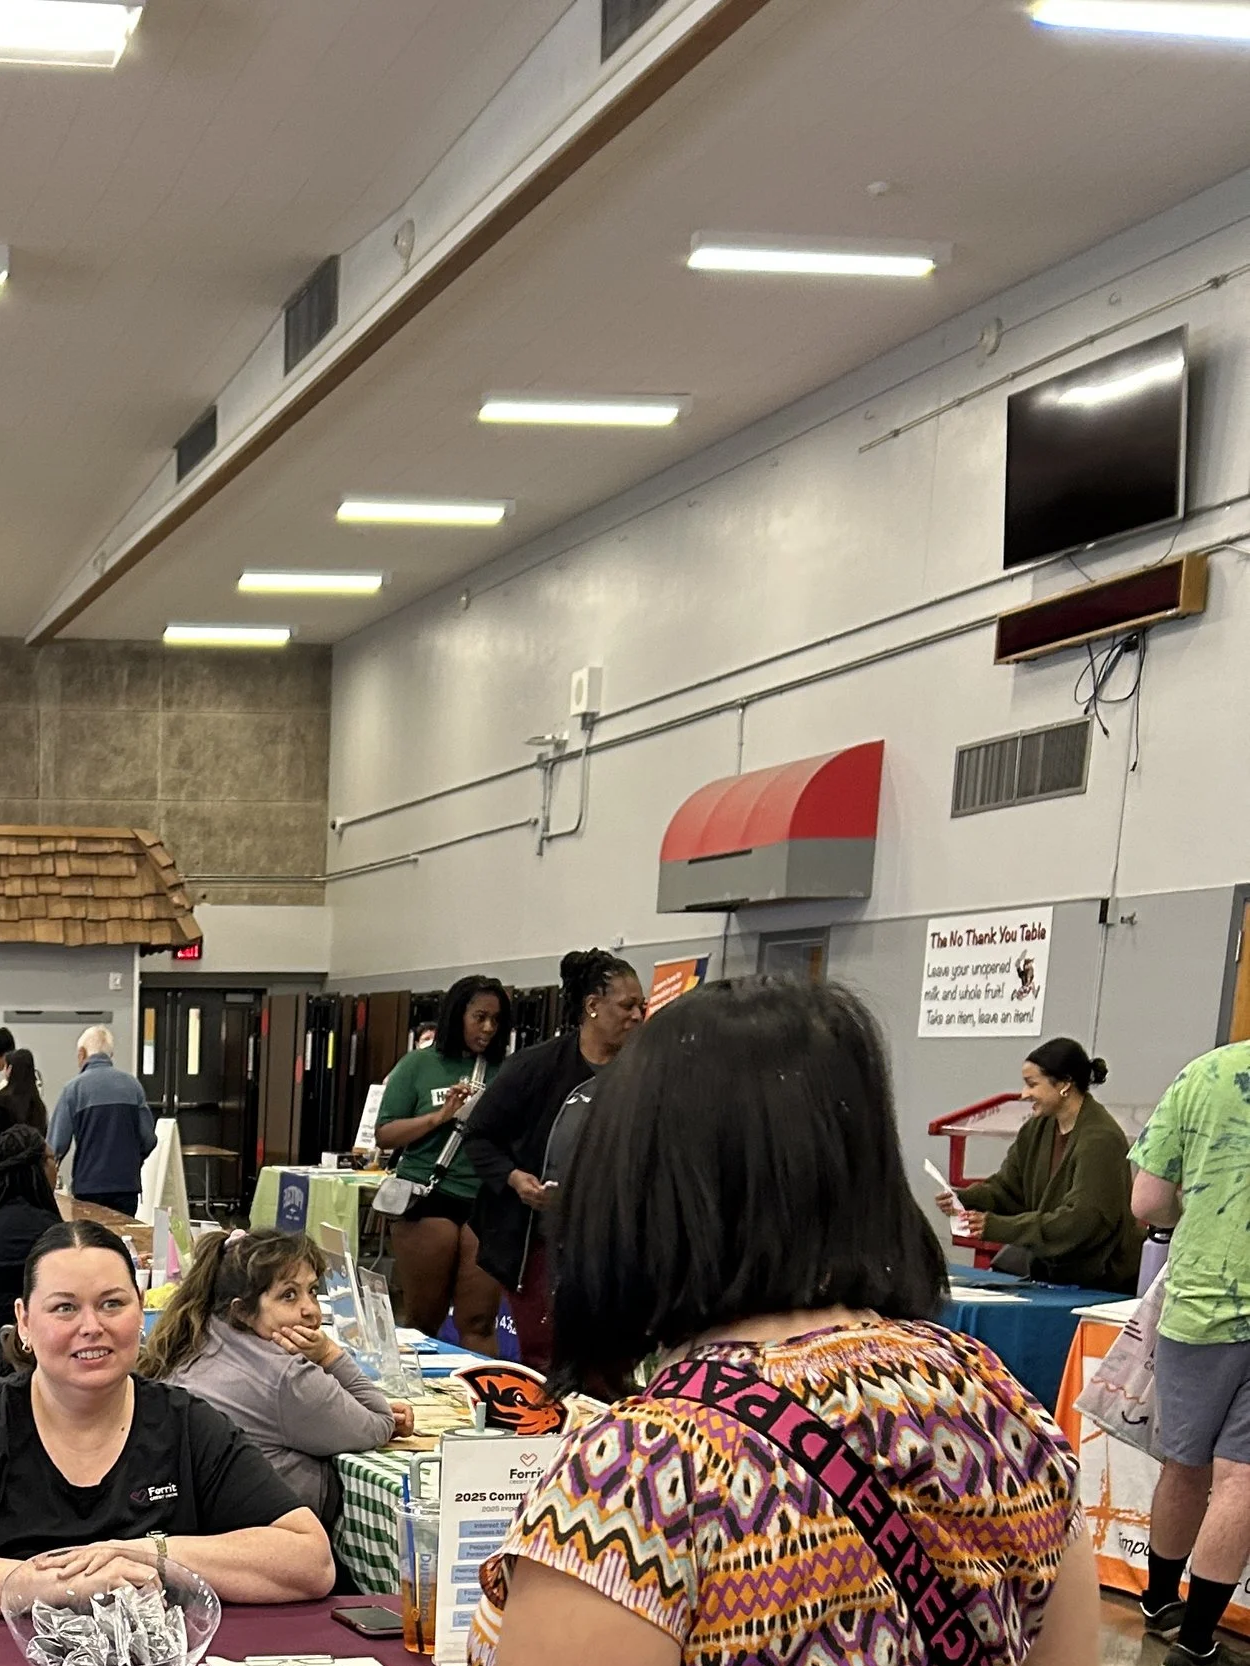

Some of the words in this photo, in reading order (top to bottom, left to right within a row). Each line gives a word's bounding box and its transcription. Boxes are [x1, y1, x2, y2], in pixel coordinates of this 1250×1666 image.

[931, 931, 947, 949] The
[950, 930, 963, 947] No
[966, 927, 997, 946] Thank
[999, 925, 1017, 943] You
[1020, 922, 1046, 941] Table
[927, 962, 949, 978] Leave
[952, 964, 969, 981] your
[972, 957, 1011, 979] unopened
[924, 985, 939, 1000] milk
[942, 984, 958, 1000] and
[959, 984, 981, 1000] whole
[985, 982, 1005, 999] fruit!
[927, 1009, 943, 1025] Take
[946, 1013, 956, 1025] an
[978, 1008, 998, 1024] leave
[1001, 1012, 1011, 1024] an
[1013, 1006, 1035, 1023] item!
[147, 1482, 178, 1497] Forrit
[455, 1492, 487, 1502] 2025
